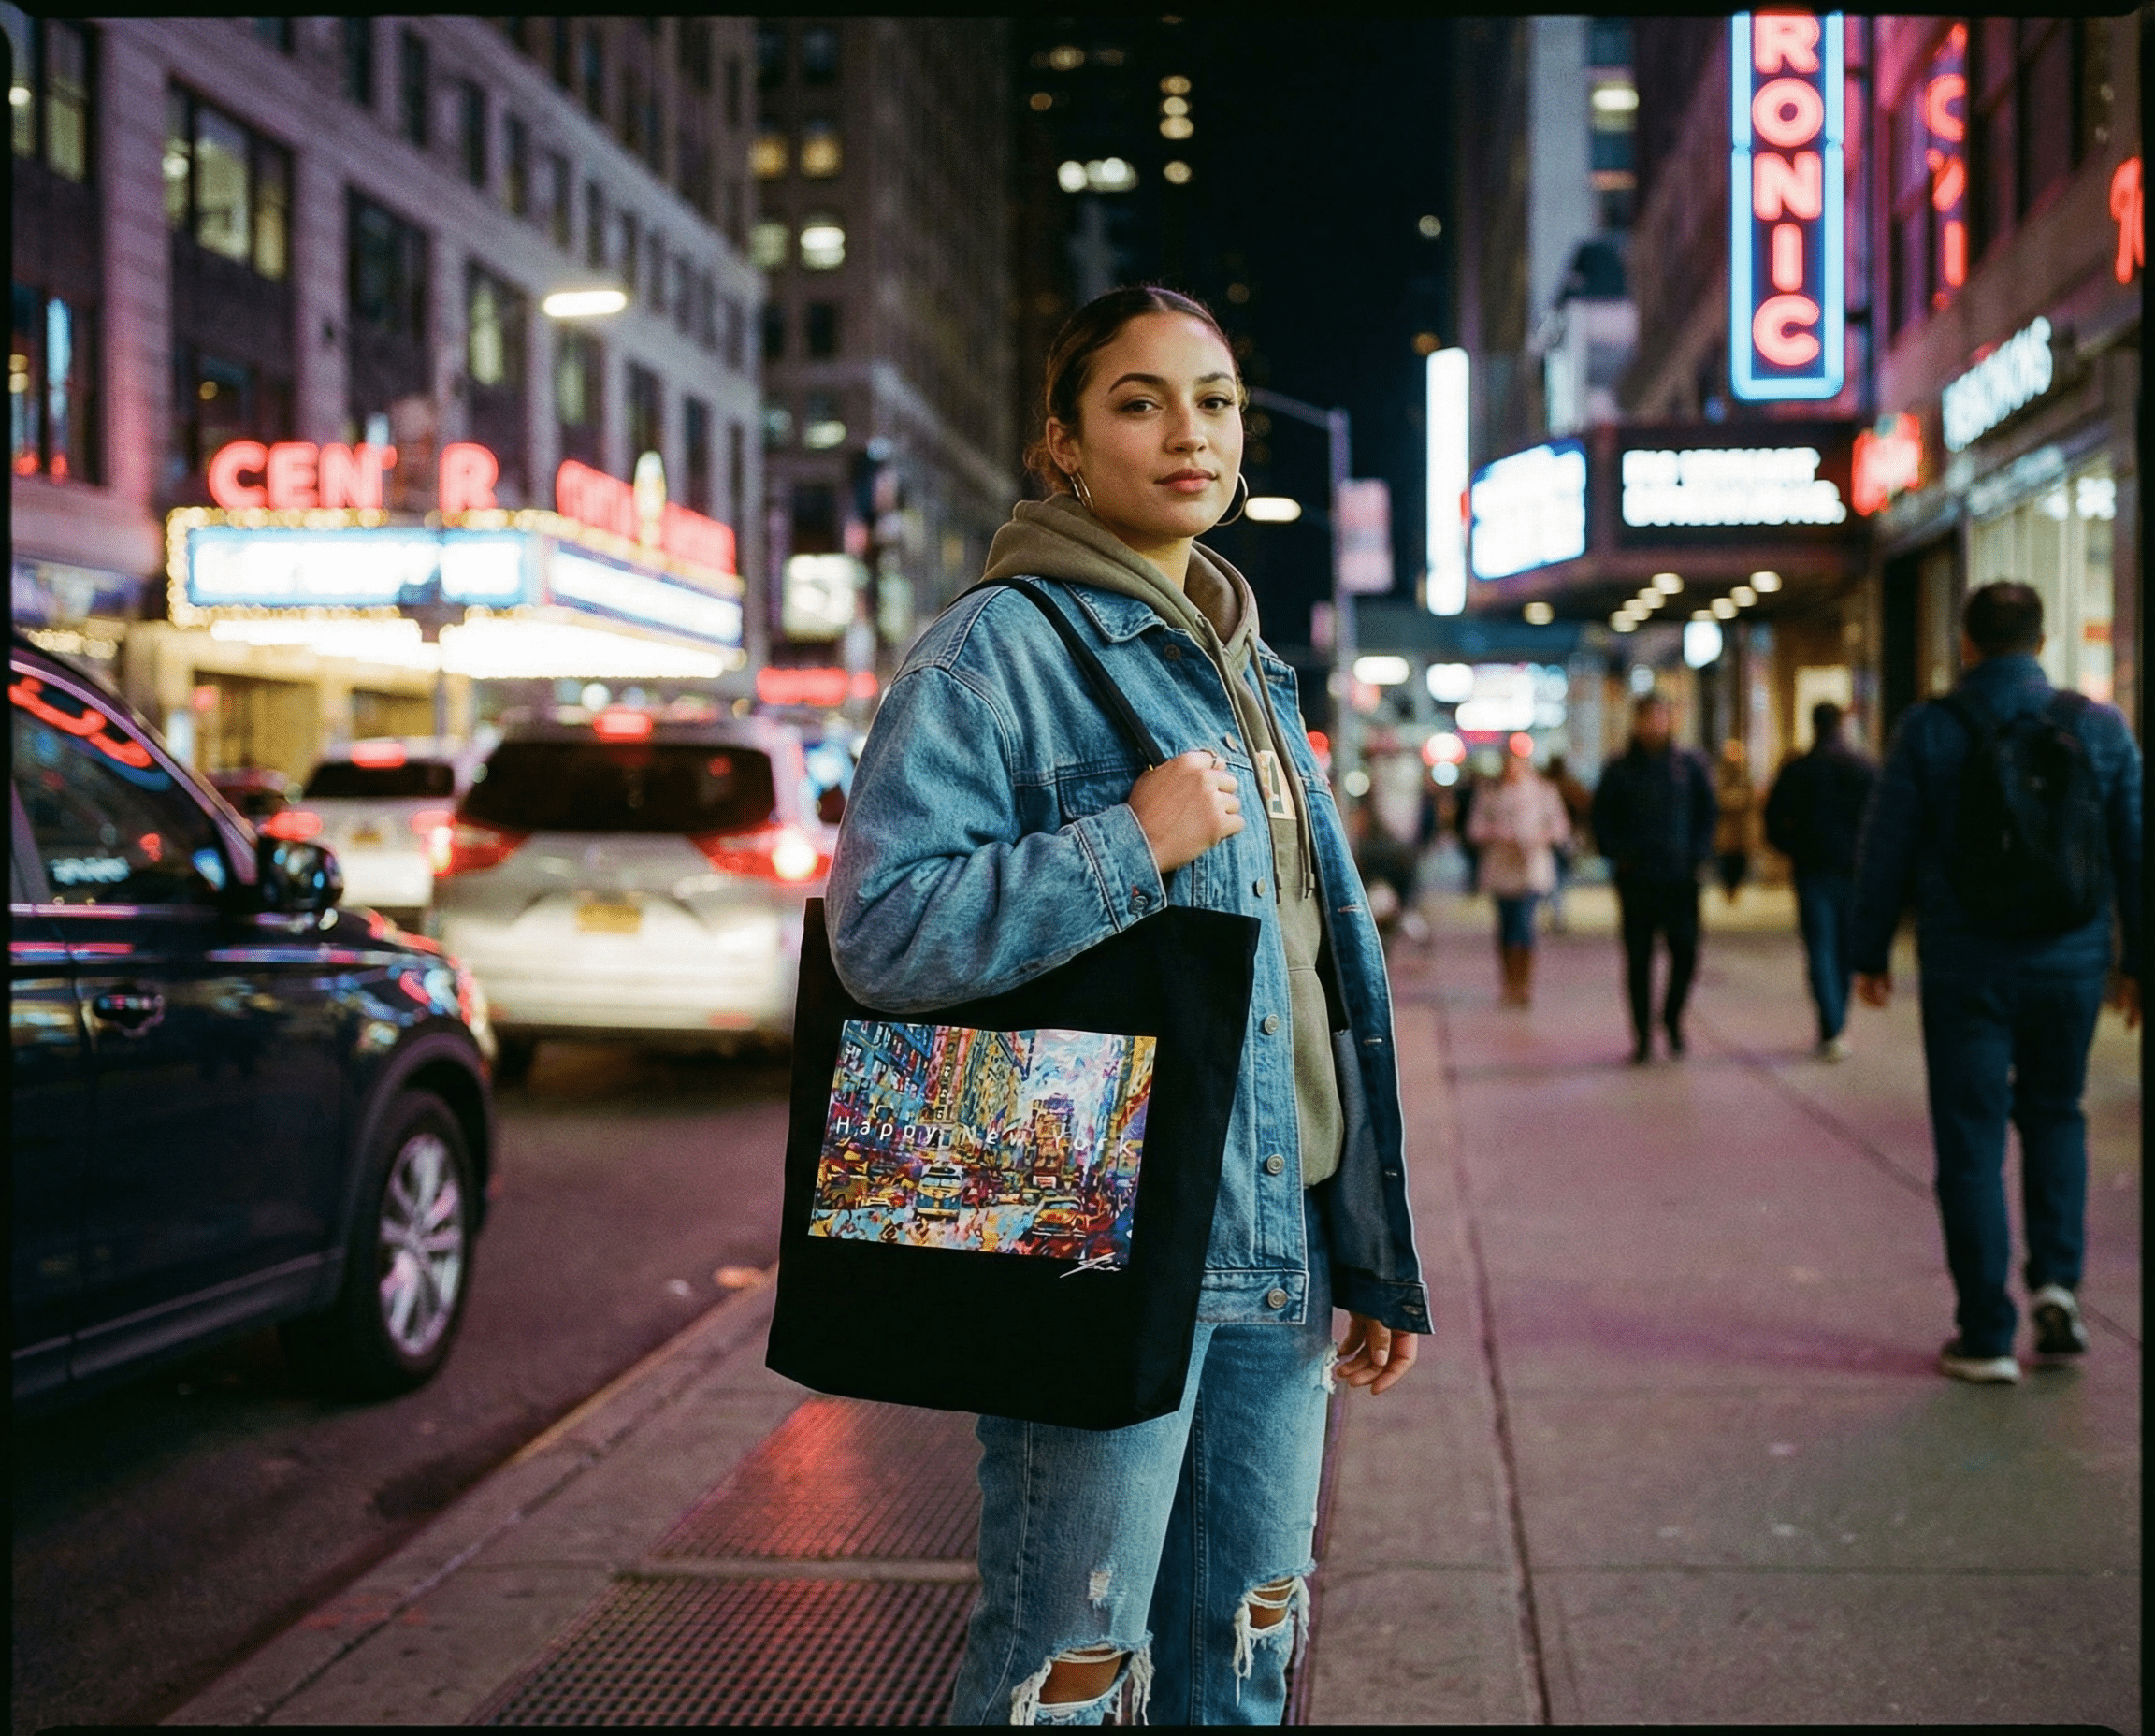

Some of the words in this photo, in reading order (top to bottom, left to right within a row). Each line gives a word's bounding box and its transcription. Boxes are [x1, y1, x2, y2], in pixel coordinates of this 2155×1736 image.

[835, 1115, 938, 1147] Happy
[960, 1124, 1034, 1149] New
[1052, 1122, 1136, 1157] York
